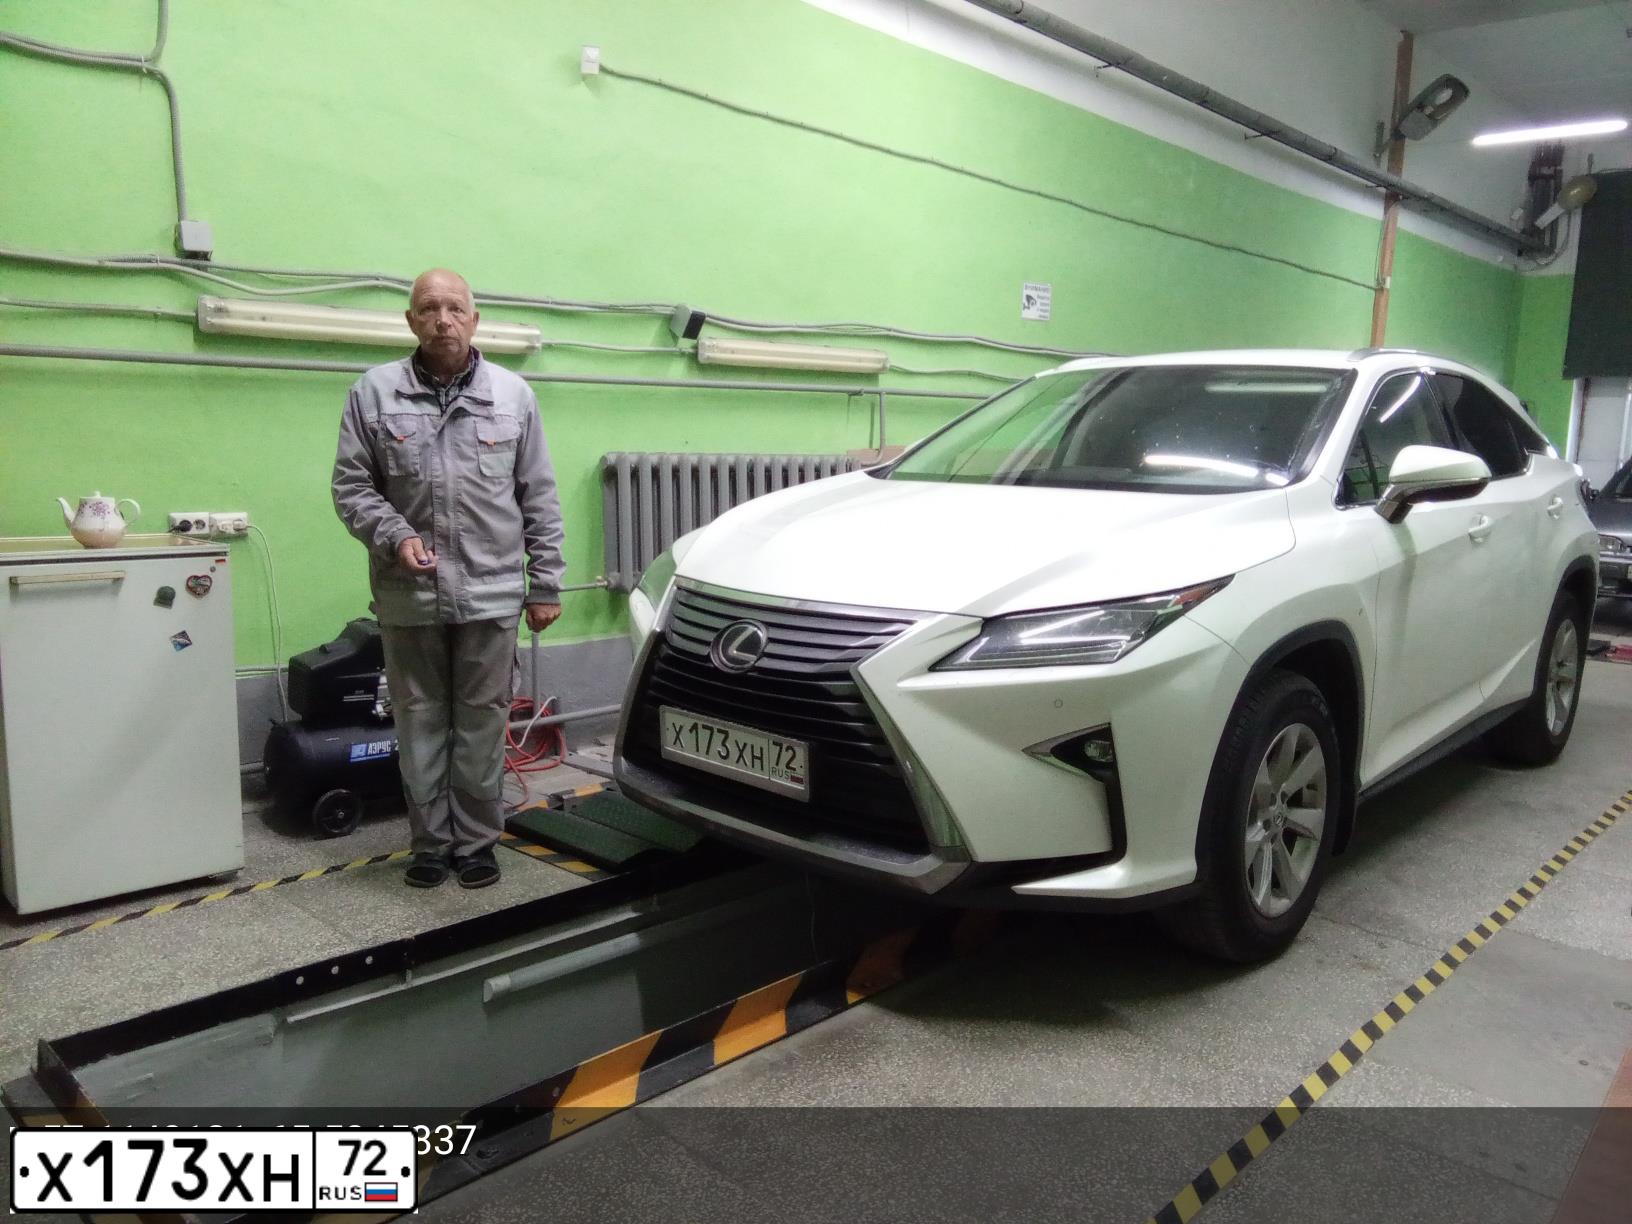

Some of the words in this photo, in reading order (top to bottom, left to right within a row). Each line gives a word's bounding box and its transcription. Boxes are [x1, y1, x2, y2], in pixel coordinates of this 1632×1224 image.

[672, 722, 764, 771] Х173ХН
[773, 741, 797, 772] 72
[771, 766, 790, 780] RUS
